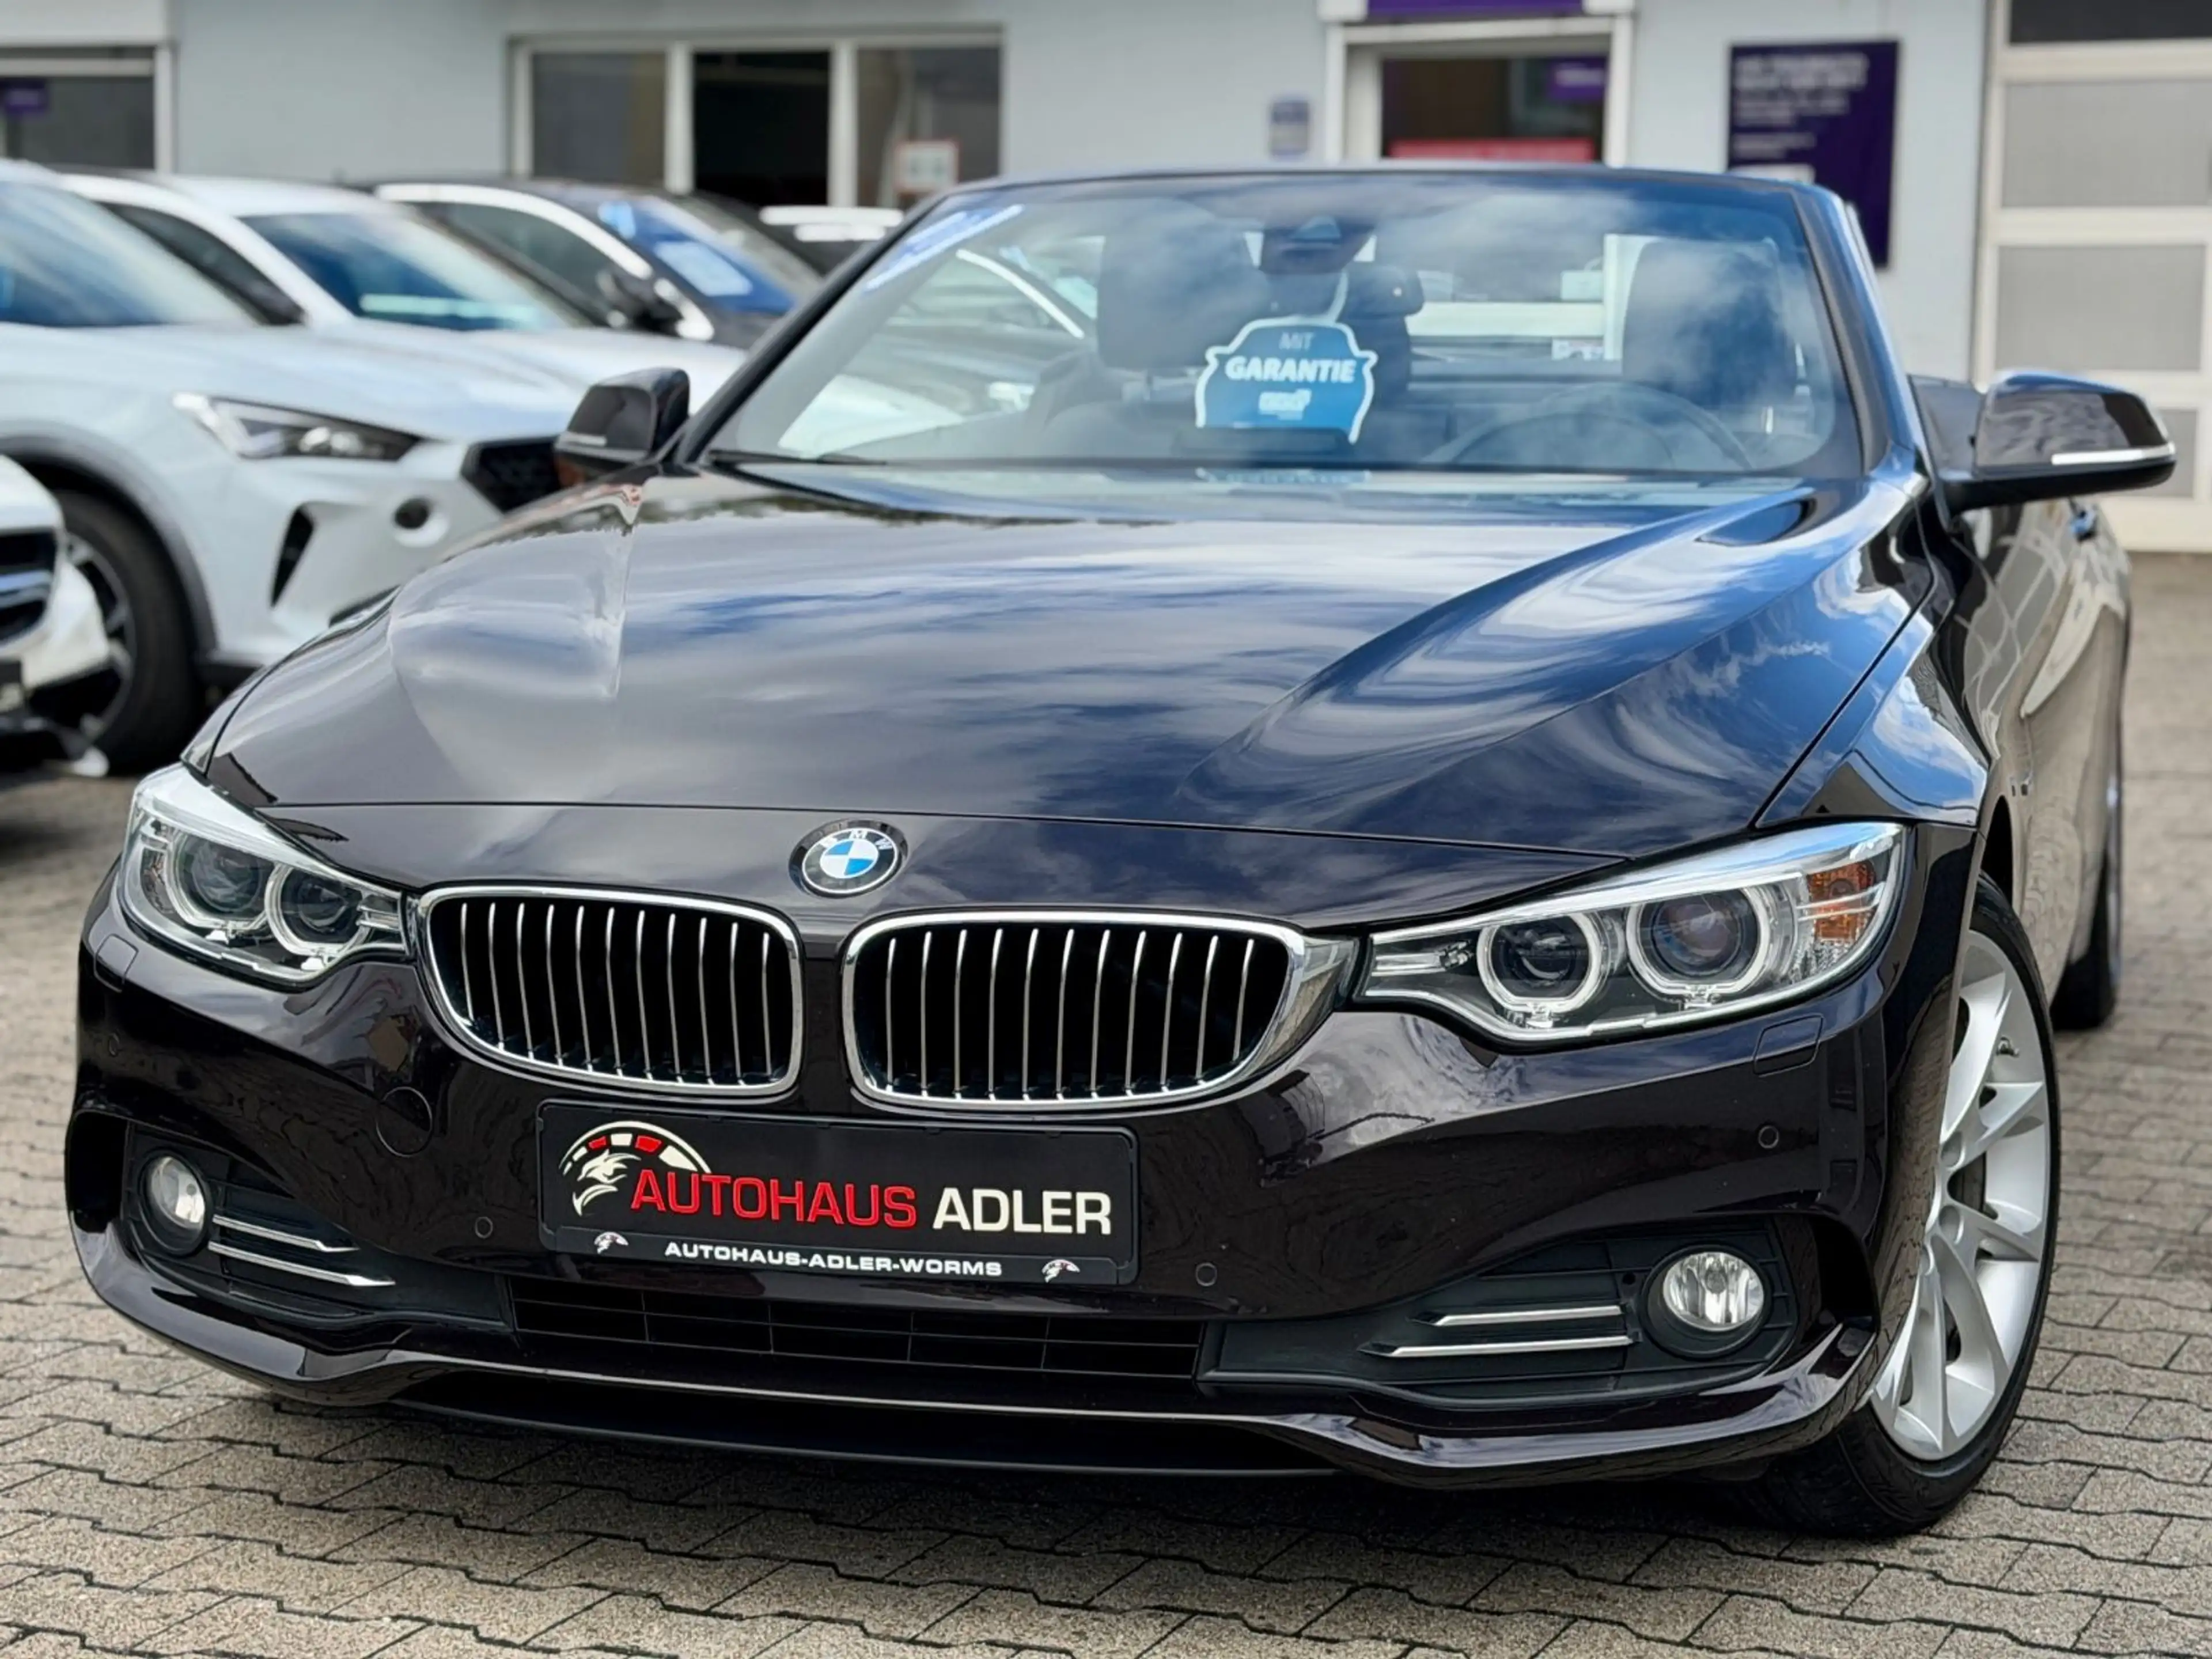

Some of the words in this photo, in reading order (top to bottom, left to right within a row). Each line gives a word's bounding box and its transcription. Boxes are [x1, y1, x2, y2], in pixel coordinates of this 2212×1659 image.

[1279, 332, 1316, 350] MIT
[1225, 356, 1357, 384] GARANTIE
[819, 830, 893, 850] BMW
[631, 1169, 918, 1228] AUTOHAUS
[932, 1187, 1111, 1235] ADLER
[664, 1241, 1002, 1277] AUTOHAUS-ADLER-WORMS
